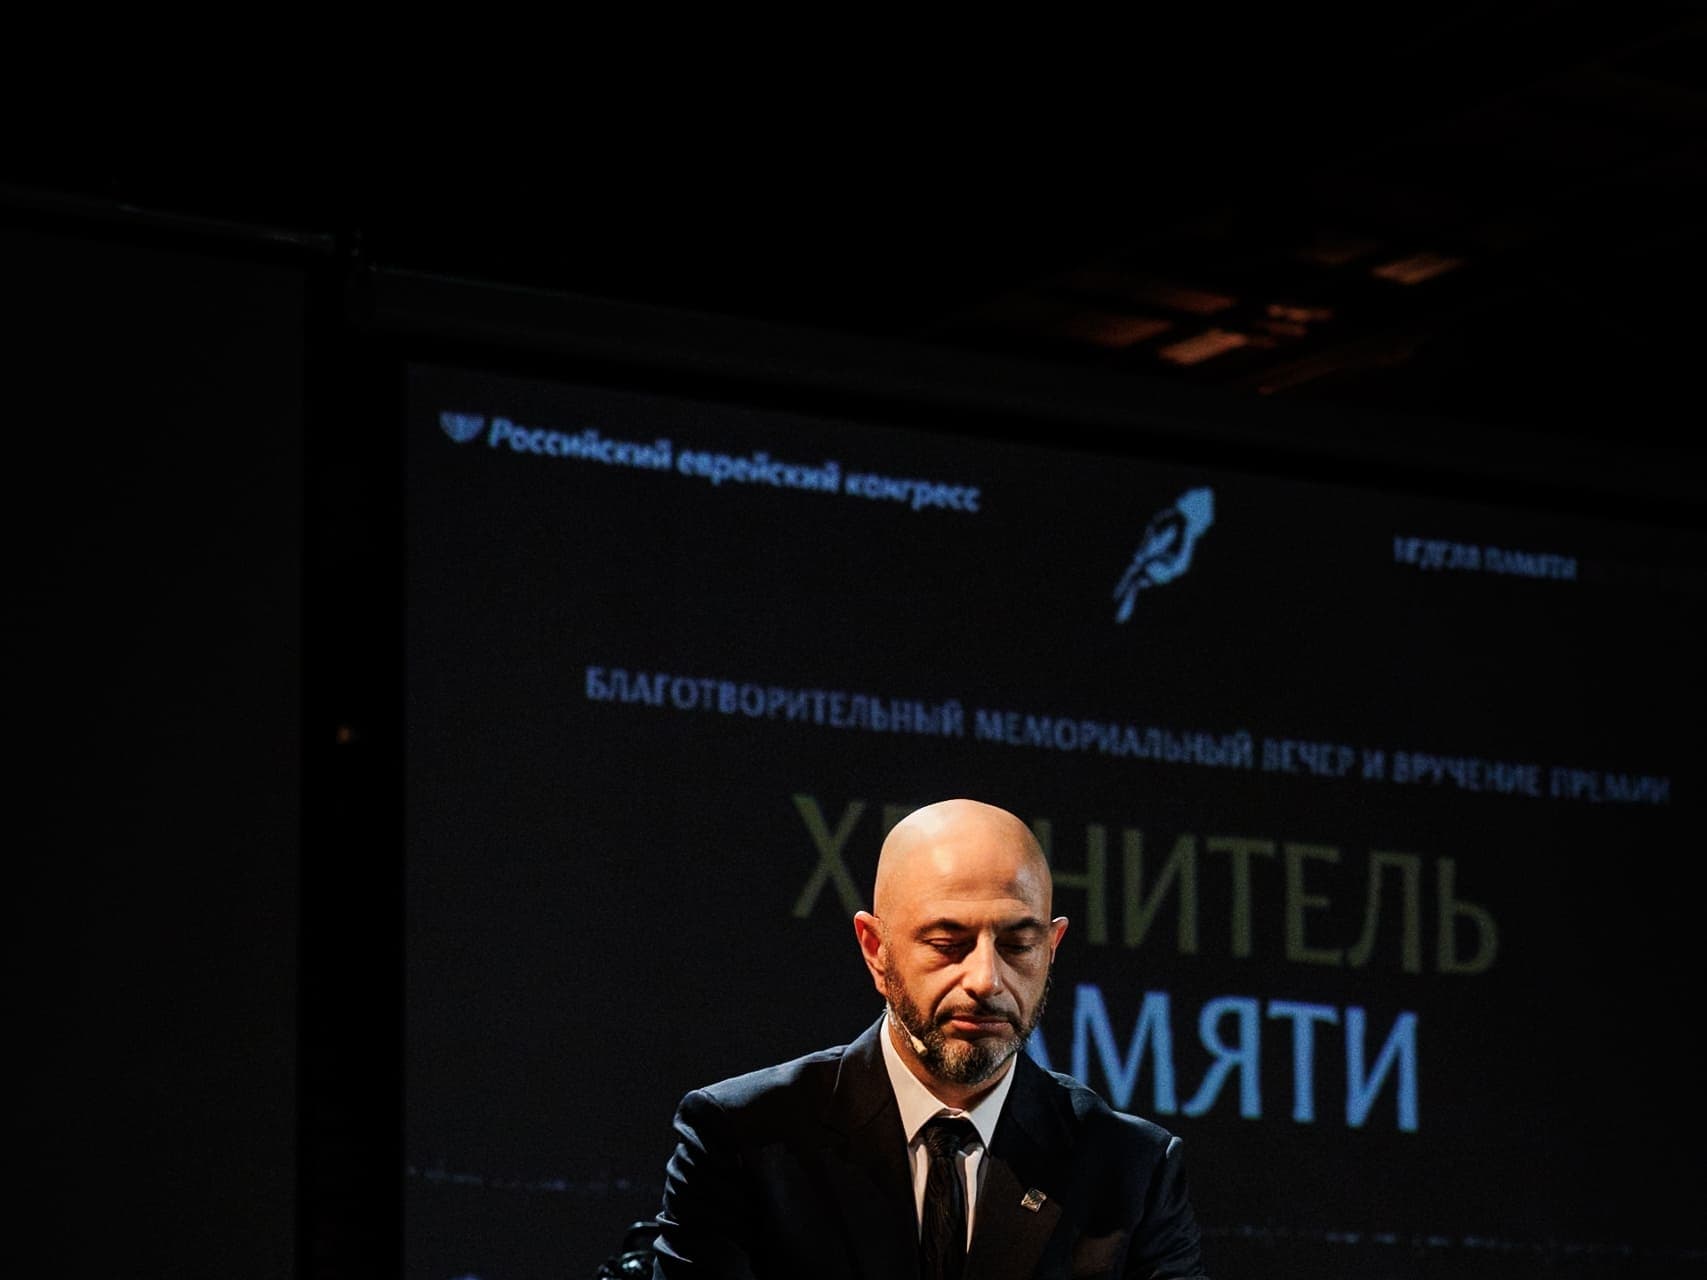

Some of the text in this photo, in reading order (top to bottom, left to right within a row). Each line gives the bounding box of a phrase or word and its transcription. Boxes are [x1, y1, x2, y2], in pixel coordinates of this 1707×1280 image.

[489, 416, 981, 513] Российский еврейский конгресс
[585, 665, 966, 738] БЛАГОТВОРИТЕЛЬНЫЙ
[975, 708, 1255, 770] МЕМОРИАЛЬНЫЙ
[1261, 736, 1356, 777] ВЕЧЕР
[1362, 748, 1387, 782] И
[1393, 750, 1543, 799] ВРУЧЕНИЕ
[792, 793, 1501, 976] ХНИТЕЛЬ
[1023, 982, 1421, 1133] МЯТИ
